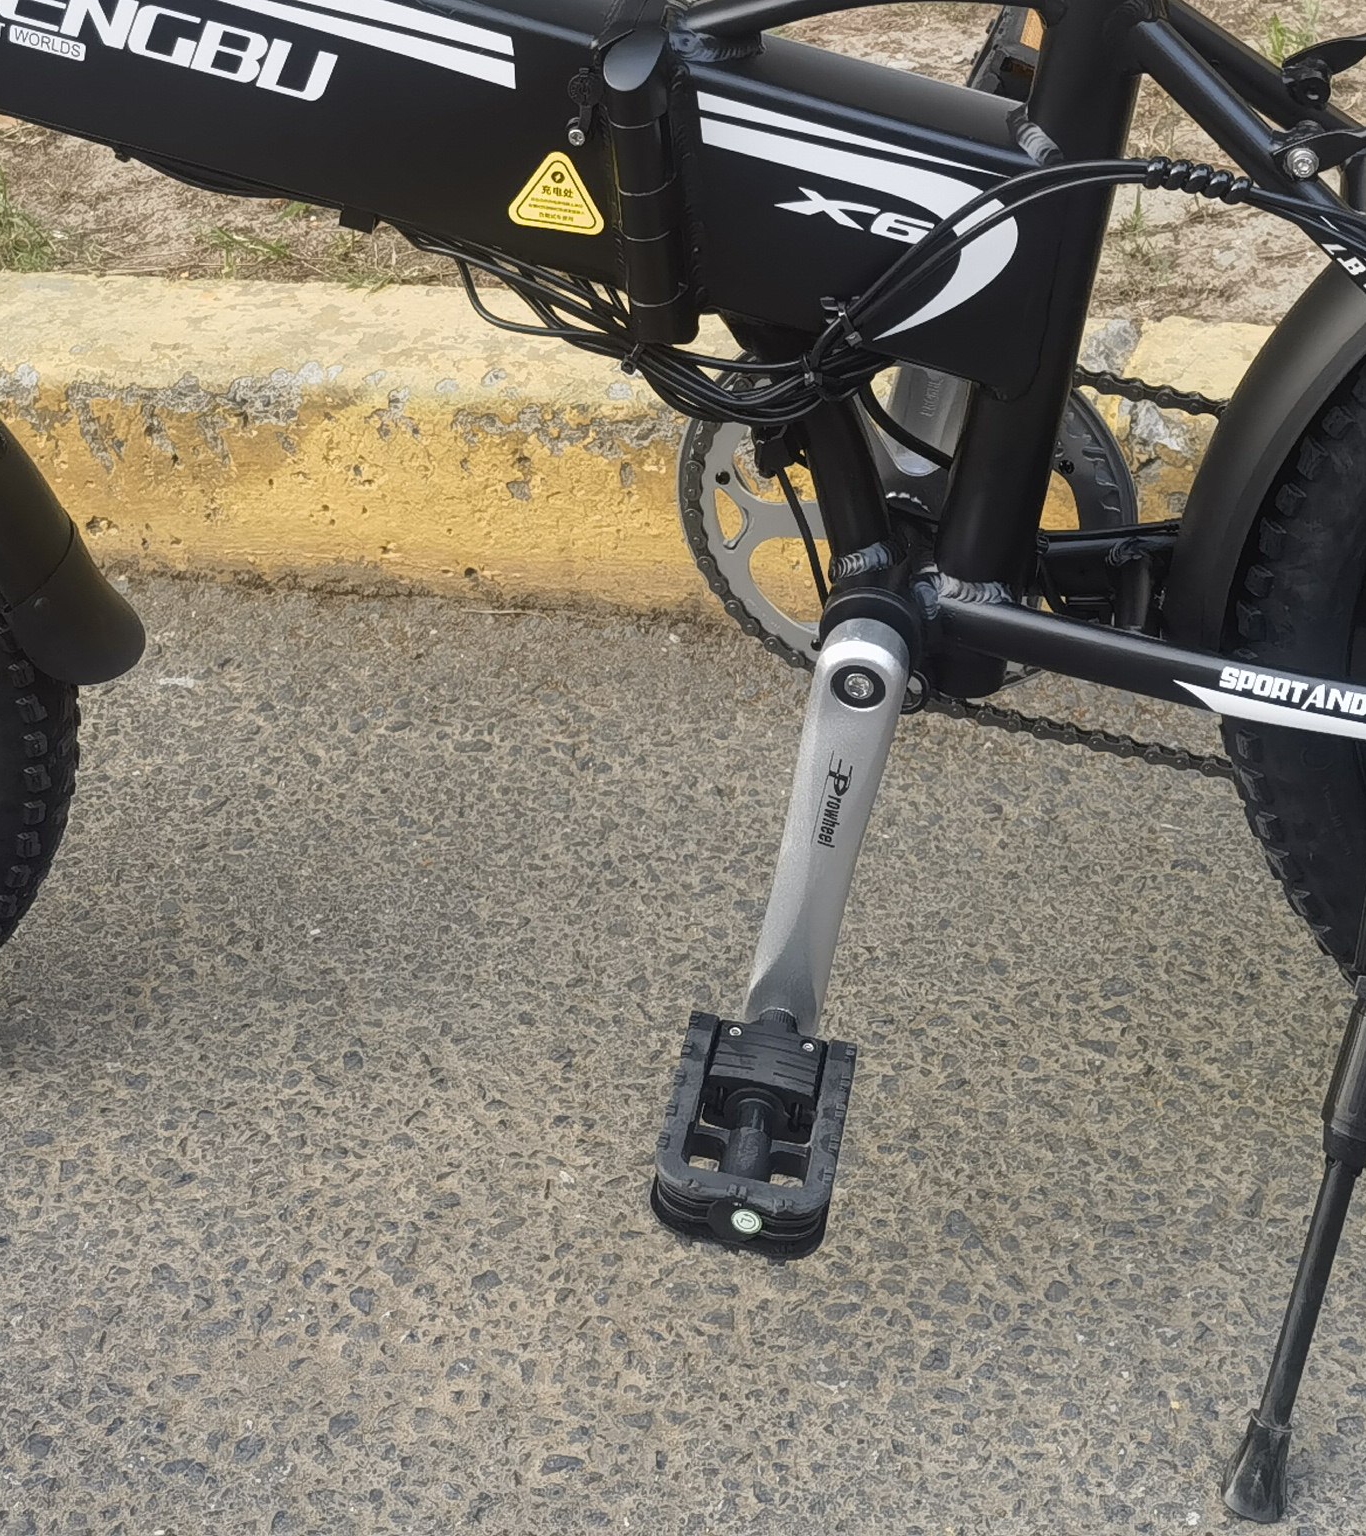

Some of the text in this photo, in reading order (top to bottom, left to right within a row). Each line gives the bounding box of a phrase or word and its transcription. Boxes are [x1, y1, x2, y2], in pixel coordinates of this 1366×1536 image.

[12, 28, 82, 59] WORLDS
[541, 185, 573, 199] 充电处
[774, 186, 935, 245] X6
[1219, 666, 1309, 704] SPORT
[816, 758, 853, 848] Prowheel
